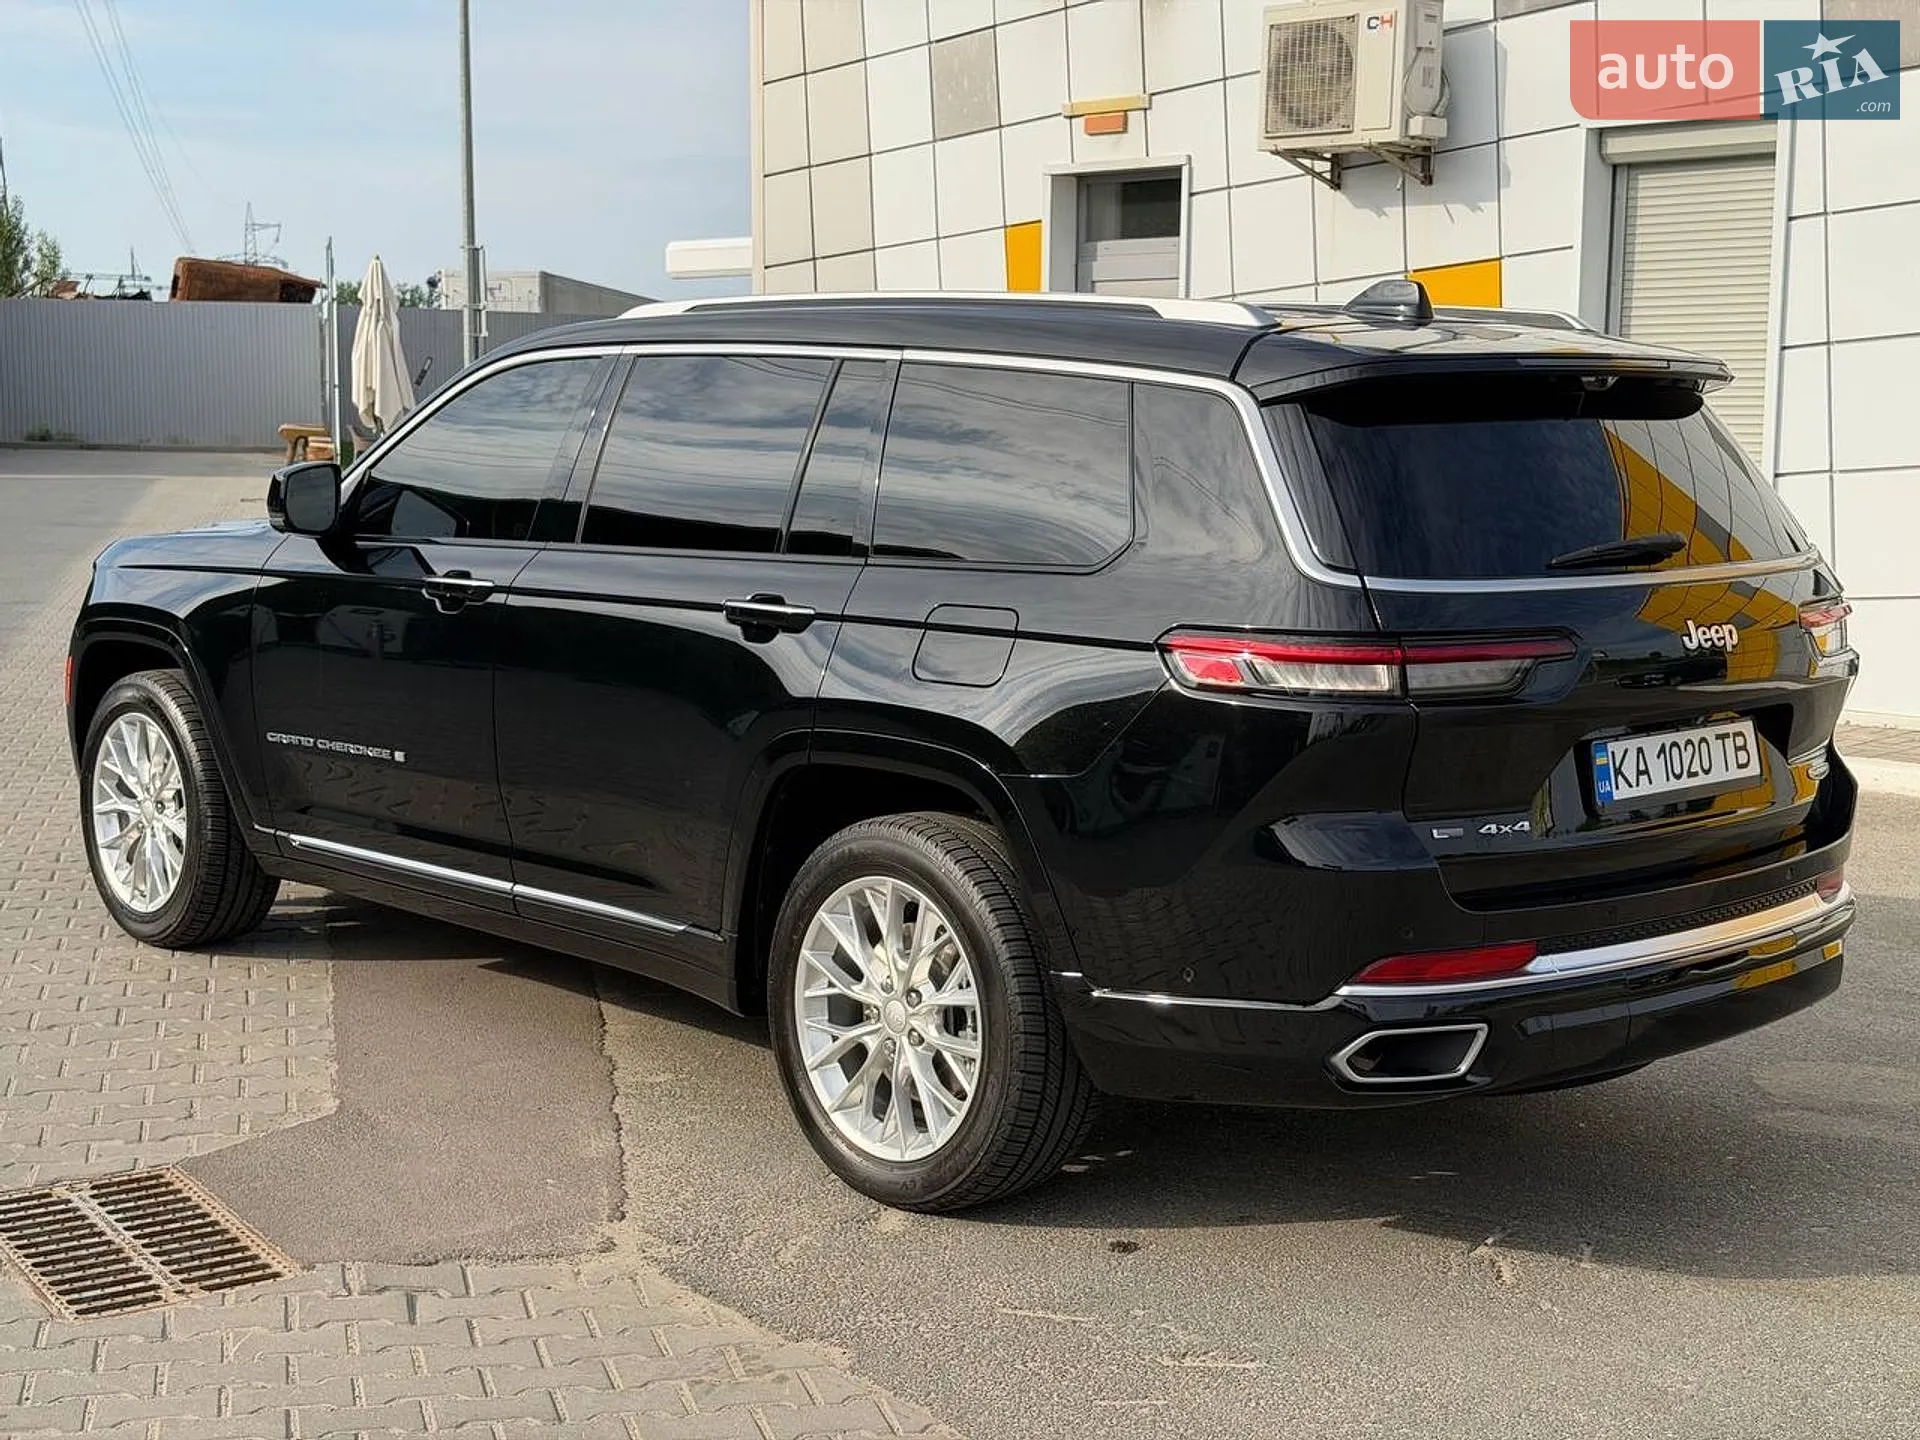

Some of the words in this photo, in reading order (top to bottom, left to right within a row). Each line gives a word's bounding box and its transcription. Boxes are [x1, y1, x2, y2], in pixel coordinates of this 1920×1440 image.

[1366, 14, 1393, 30] CH
[1682, 619, 1739, 652] Jeep
[266, 732, 314, 747] GRAND
[316, 739, 392, 760] CHEROKEE
[1611, 747, 1653, 790] KA
[1656, 739, 1712, 782] 1020
[1715, 731, 1751, 772] TB
[1599, 780, 1611, 793] UA
[1479, 821, 1530, 834] 4x4
